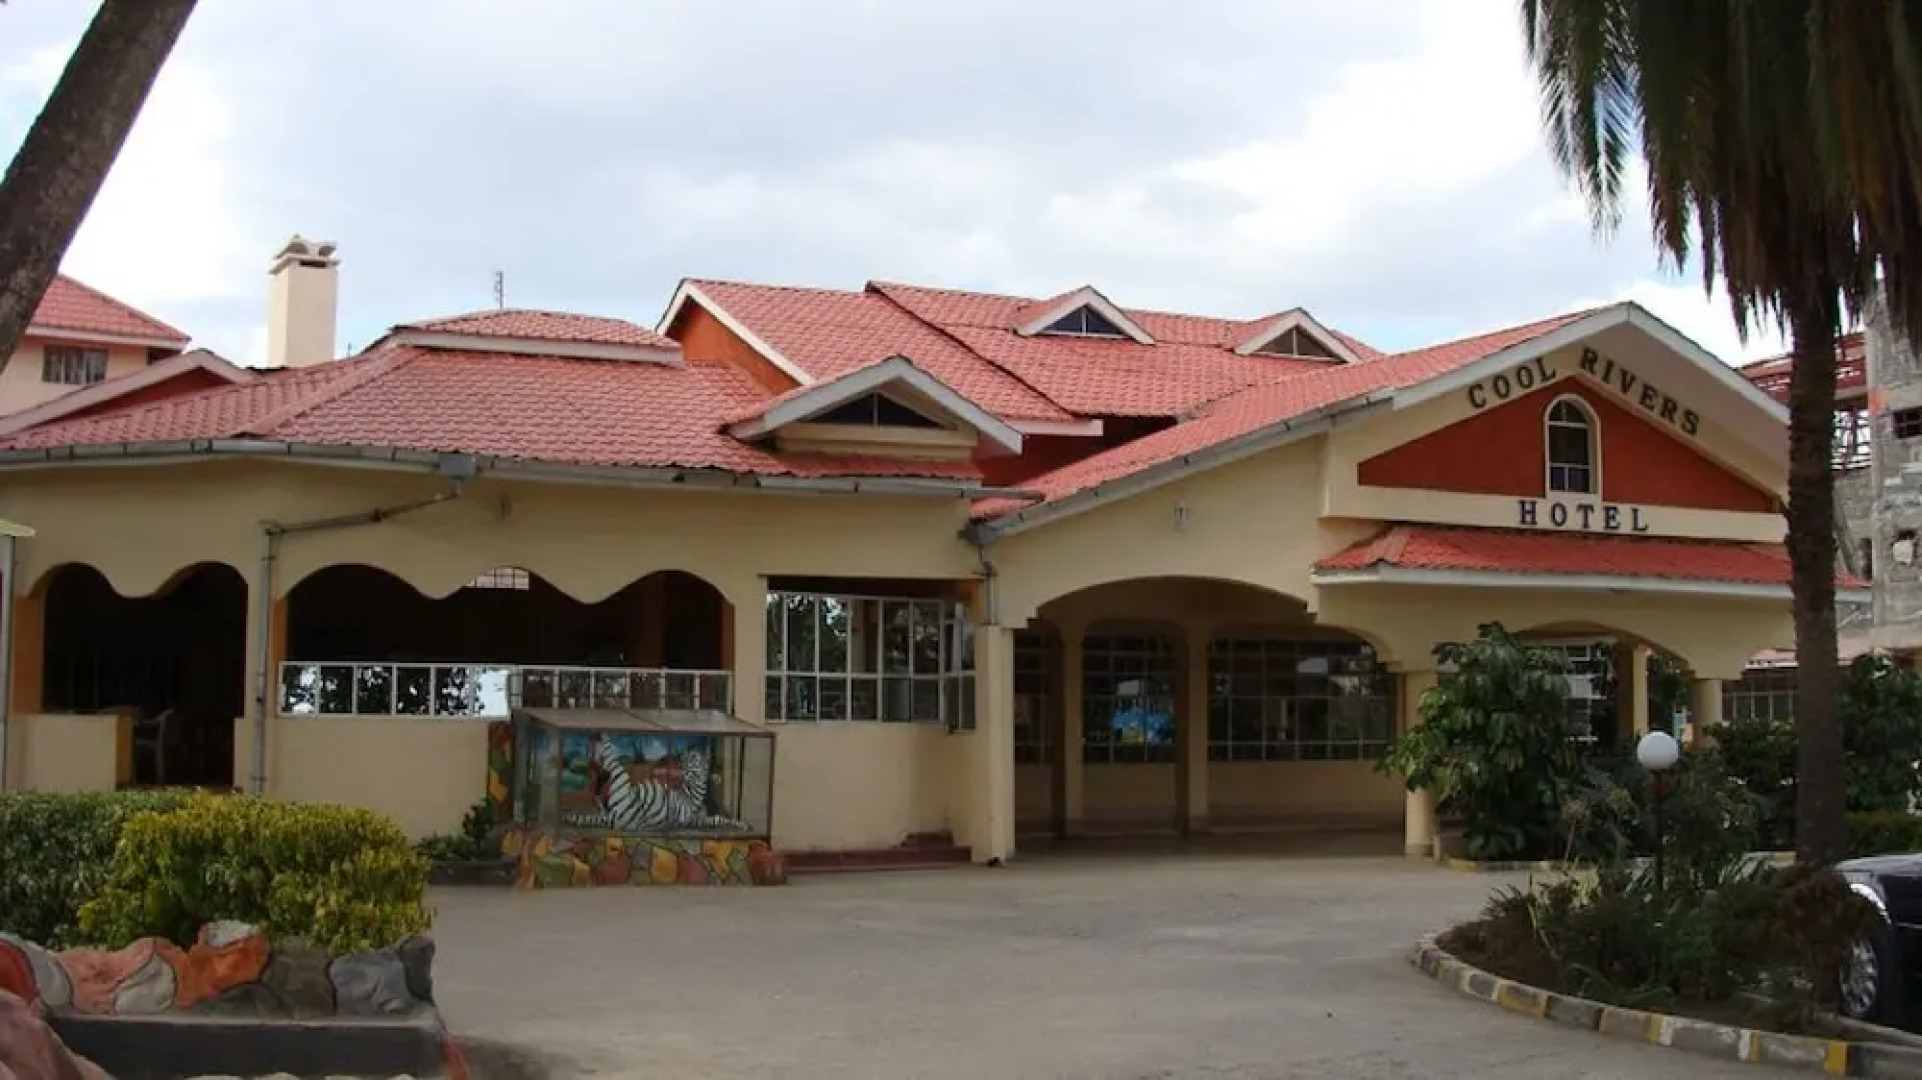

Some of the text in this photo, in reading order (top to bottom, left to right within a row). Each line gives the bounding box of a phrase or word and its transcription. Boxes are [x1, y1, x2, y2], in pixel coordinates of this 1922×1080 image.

[1468, 347, 1700, 435] COOL RIVERS
[1519, 500, 1648, 531] HOTEL
